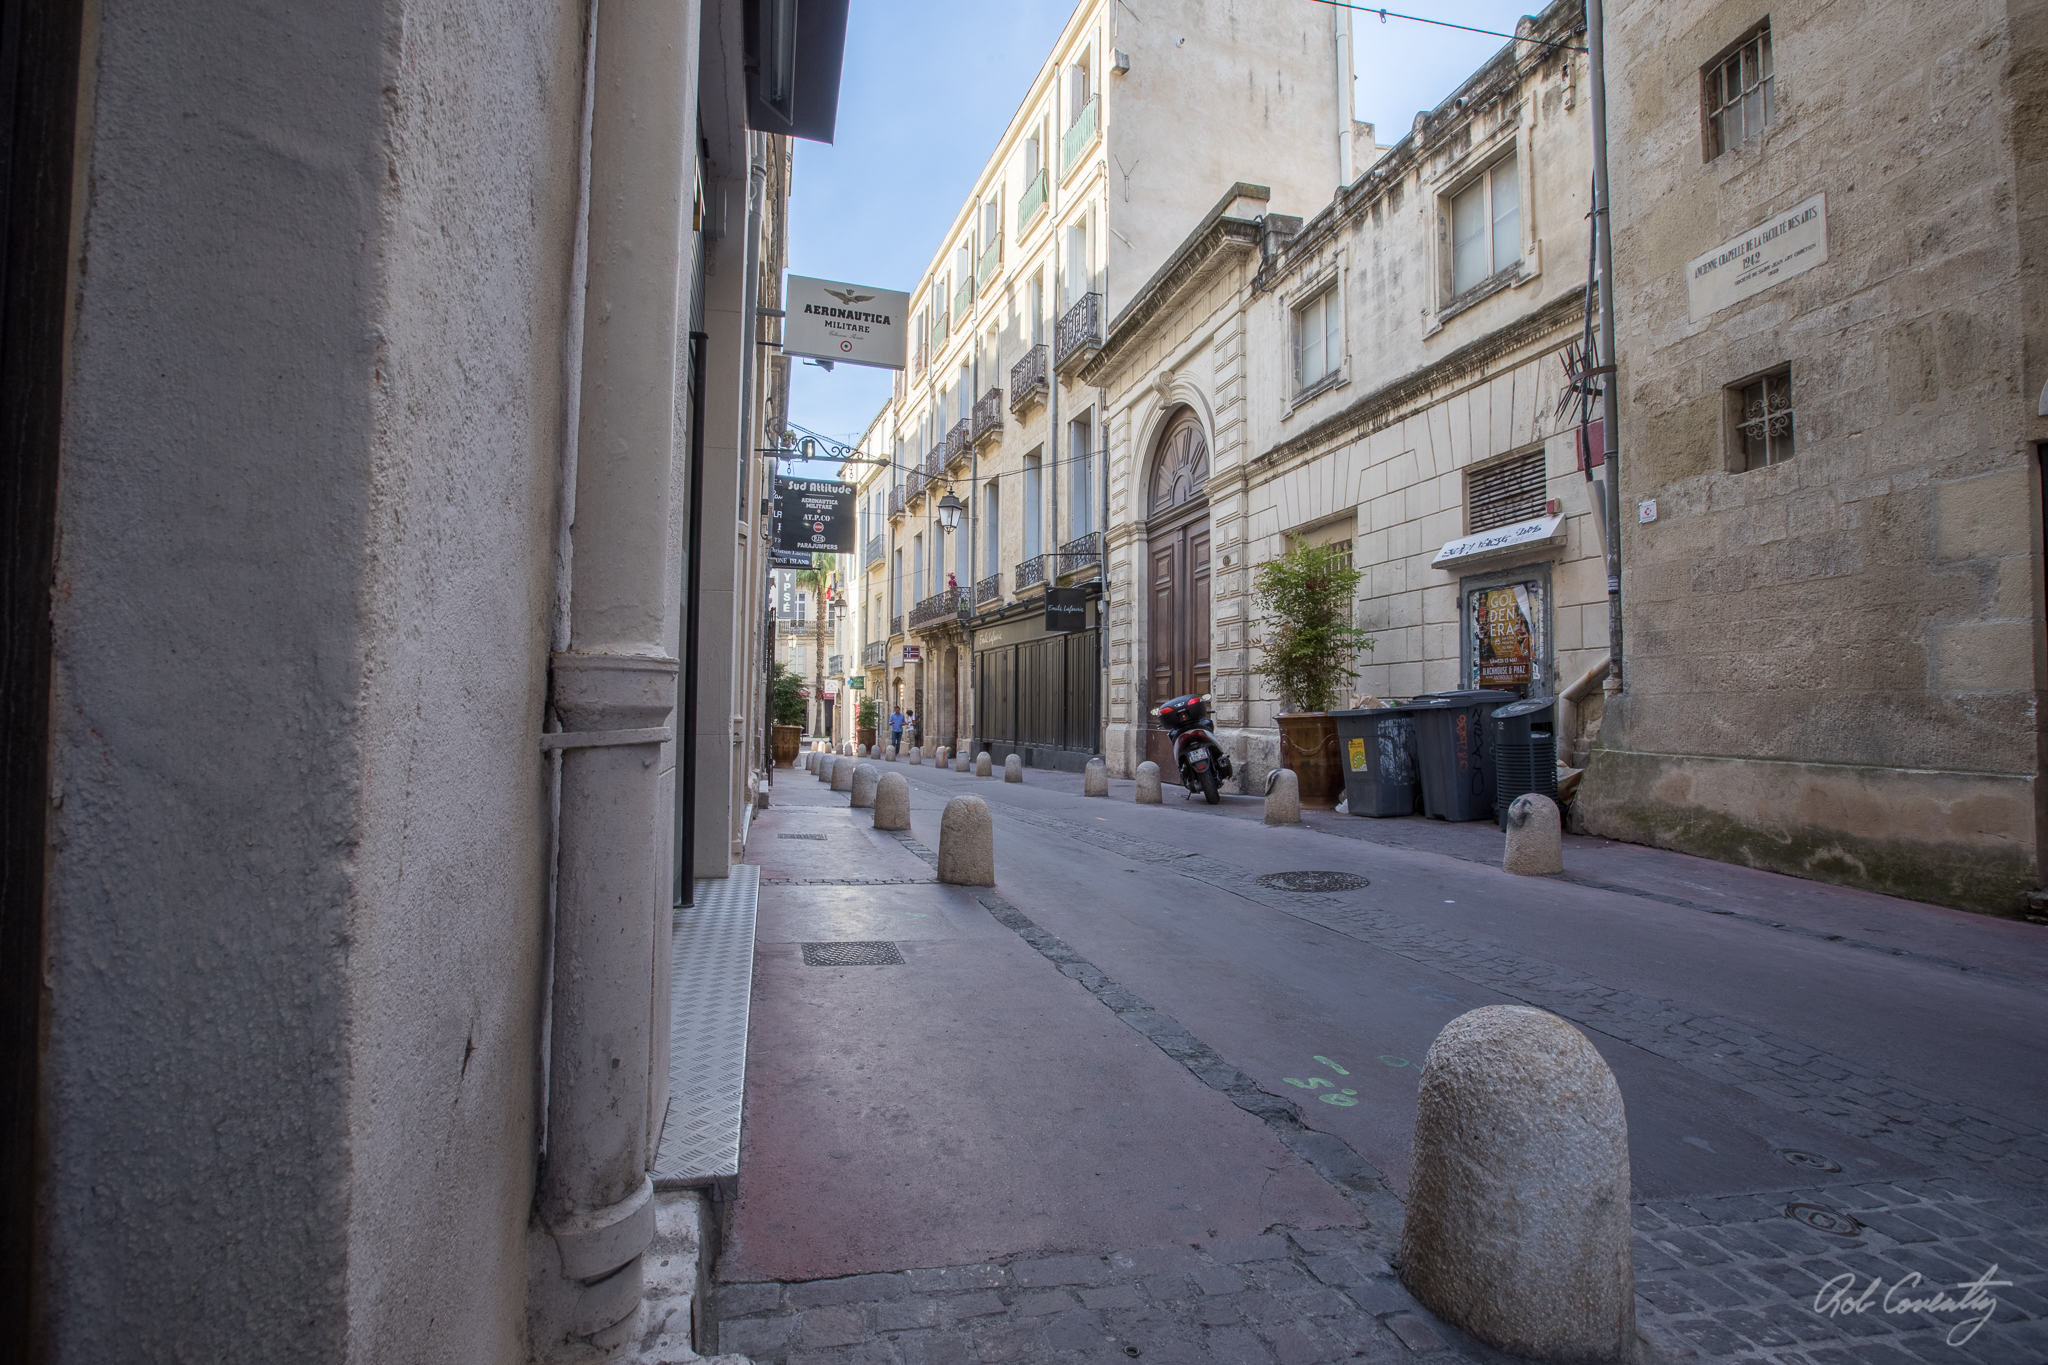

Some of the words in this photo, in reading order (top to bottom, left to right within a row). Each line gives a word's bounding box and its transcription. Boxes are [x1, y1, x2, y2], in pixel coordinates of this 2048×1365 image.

[1694, 258, 1718, 279] ANCIENNE
[1718, 243, 1745, 267] CHAPELLE
[1746, 239, 1753, 253] DE
[1754, 235, 1762, 249] LA
[1762, 220, 1787, 244] FACULTÉ
[1788, 214, 1800, 231] DES
[1800, 205, 1818, 225] ARTS
[804, 304, 891, 325] AERONAUTICA
[824, 320, 870, 333] MILITARE
[788, 480, 807, 491] Sud
[809, 482, 852, 495] Attitude
[801, 497, 838, 506] AERONAUTICA
[797, 542, 838, 550] PARAJUMPERS
[1047, 604, 1062, 612] Emile
[1490, 593, 1516, 608] GOL
[1490, 607, 1515, 623] DEN
[1490, 622, 1515, 637] ERA
